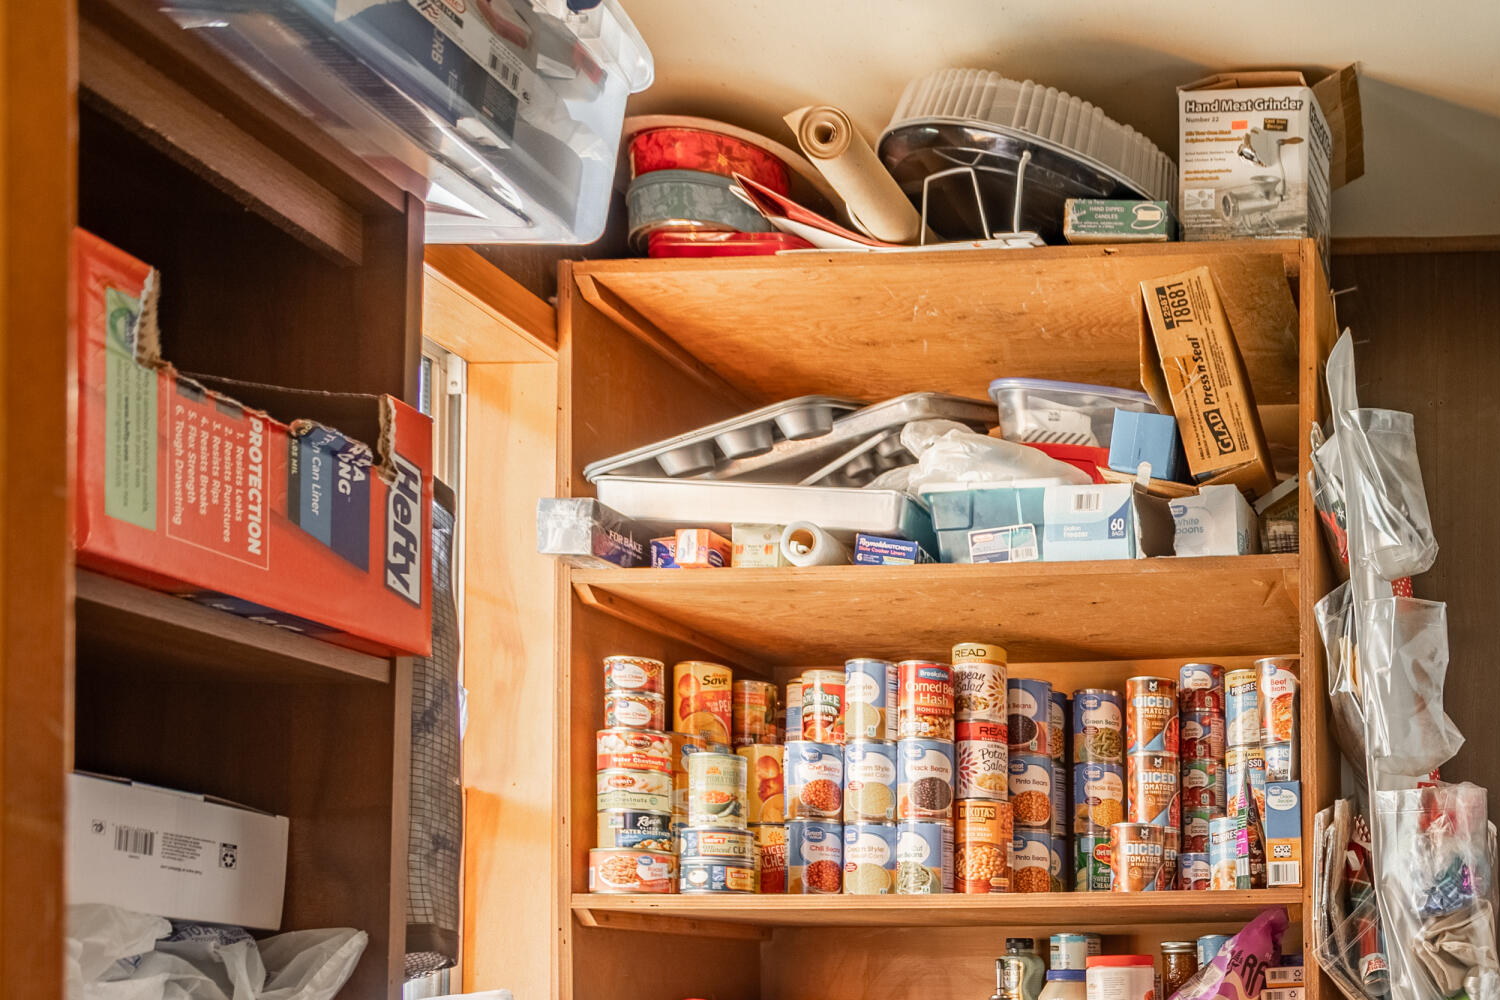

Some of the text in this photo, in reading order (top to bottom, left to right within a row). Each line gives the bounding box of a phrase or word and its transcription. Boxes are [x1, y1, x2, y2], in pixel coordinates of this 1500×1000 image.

[1185, 98, 1303, 114] Hand Meat Grinder
[1185, 116, 1210, 124] Number
[1167, 281, 1193, 328] 78681
[1187, 335, 1236, 455] GLAD Press Seal
[173, 421, 184, 456] Tough
[187, 424, 197, 450] Flex
[200, 431, 209, 474] Resists
[212, 436, 221, 477] Resists
[224, 440, 233, 482] Resists
[185, 453, 197, 504] Strength
[235, 445, 245, 487] Resists
[172, 459, 184, 526] Drawstring
[211, 479, 220, 505] Rips
[247, 417, 263, 556] PROTECTION
[310, 455, 322, 517] Can Liner
[223, 484, 233, 543] Punctures
[234, 488, 244, 523] Leaks
[389, 459, 420, 595] Hefty
[1110, 517, 1124, 530] 60
[609, 531, 643, 554] FOR BAKE
[857, 553, 863, 561] 6
[954, 648, 987, 659] READ
[702, 675, 728, 686] Save
[919, 669, 949, 679] Brookdale
[1270, 679, 1287, 687] Beef
[919, 692, 949, 705] Hash
[1084, 718, 1104, 726] Green
[1140, 772, 1175, 784] DICED
[1126, 843, 1162, 856] DICED
